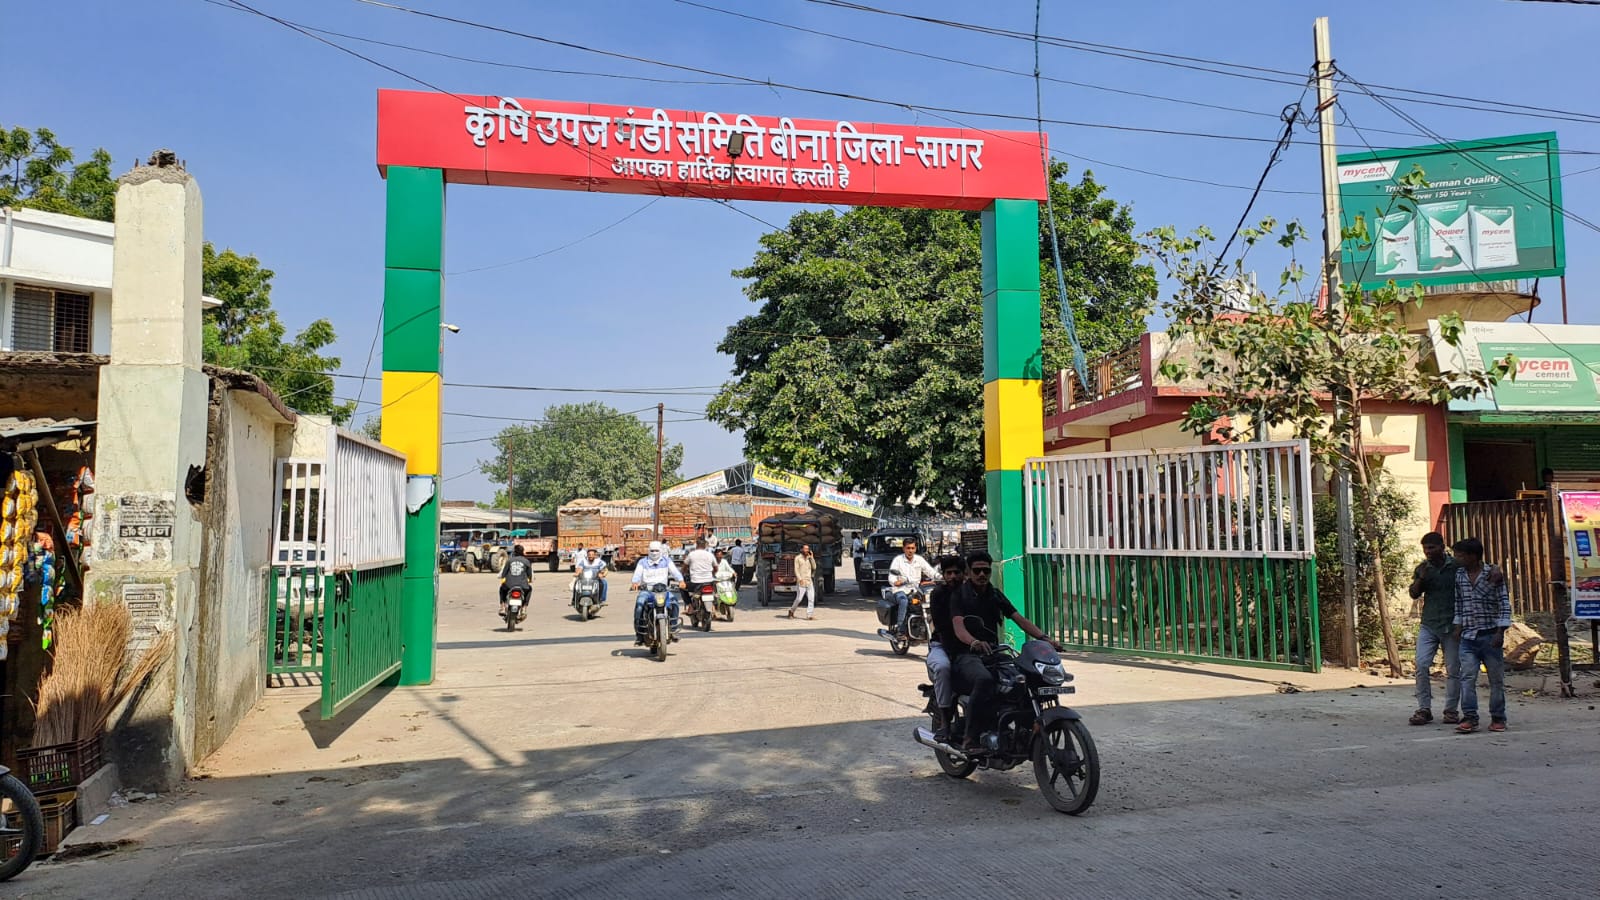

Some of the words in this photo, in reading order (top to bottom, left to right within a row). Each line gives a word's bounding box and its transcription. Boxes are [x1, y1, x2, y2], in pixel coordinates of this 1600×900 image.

[464, 97, 532, 147] कृषि
[535, 110, 611, 149] उपज
[614, 107, 673, 153] मंडी
[769, 117, 831, 161] बीना
[611, 156, 672, 178] आपका
[677, 155, 731, 181] हार्दिक
[734, 163, 787, 185] स्वागत
[792, 165, 834, 187] करती
[838, 163, 850, 189] है
[1343, 166, 1387, 178] mycem
[1463, 174, 1501, 185] Quality
[1435, 190, 1449, 198] 150
